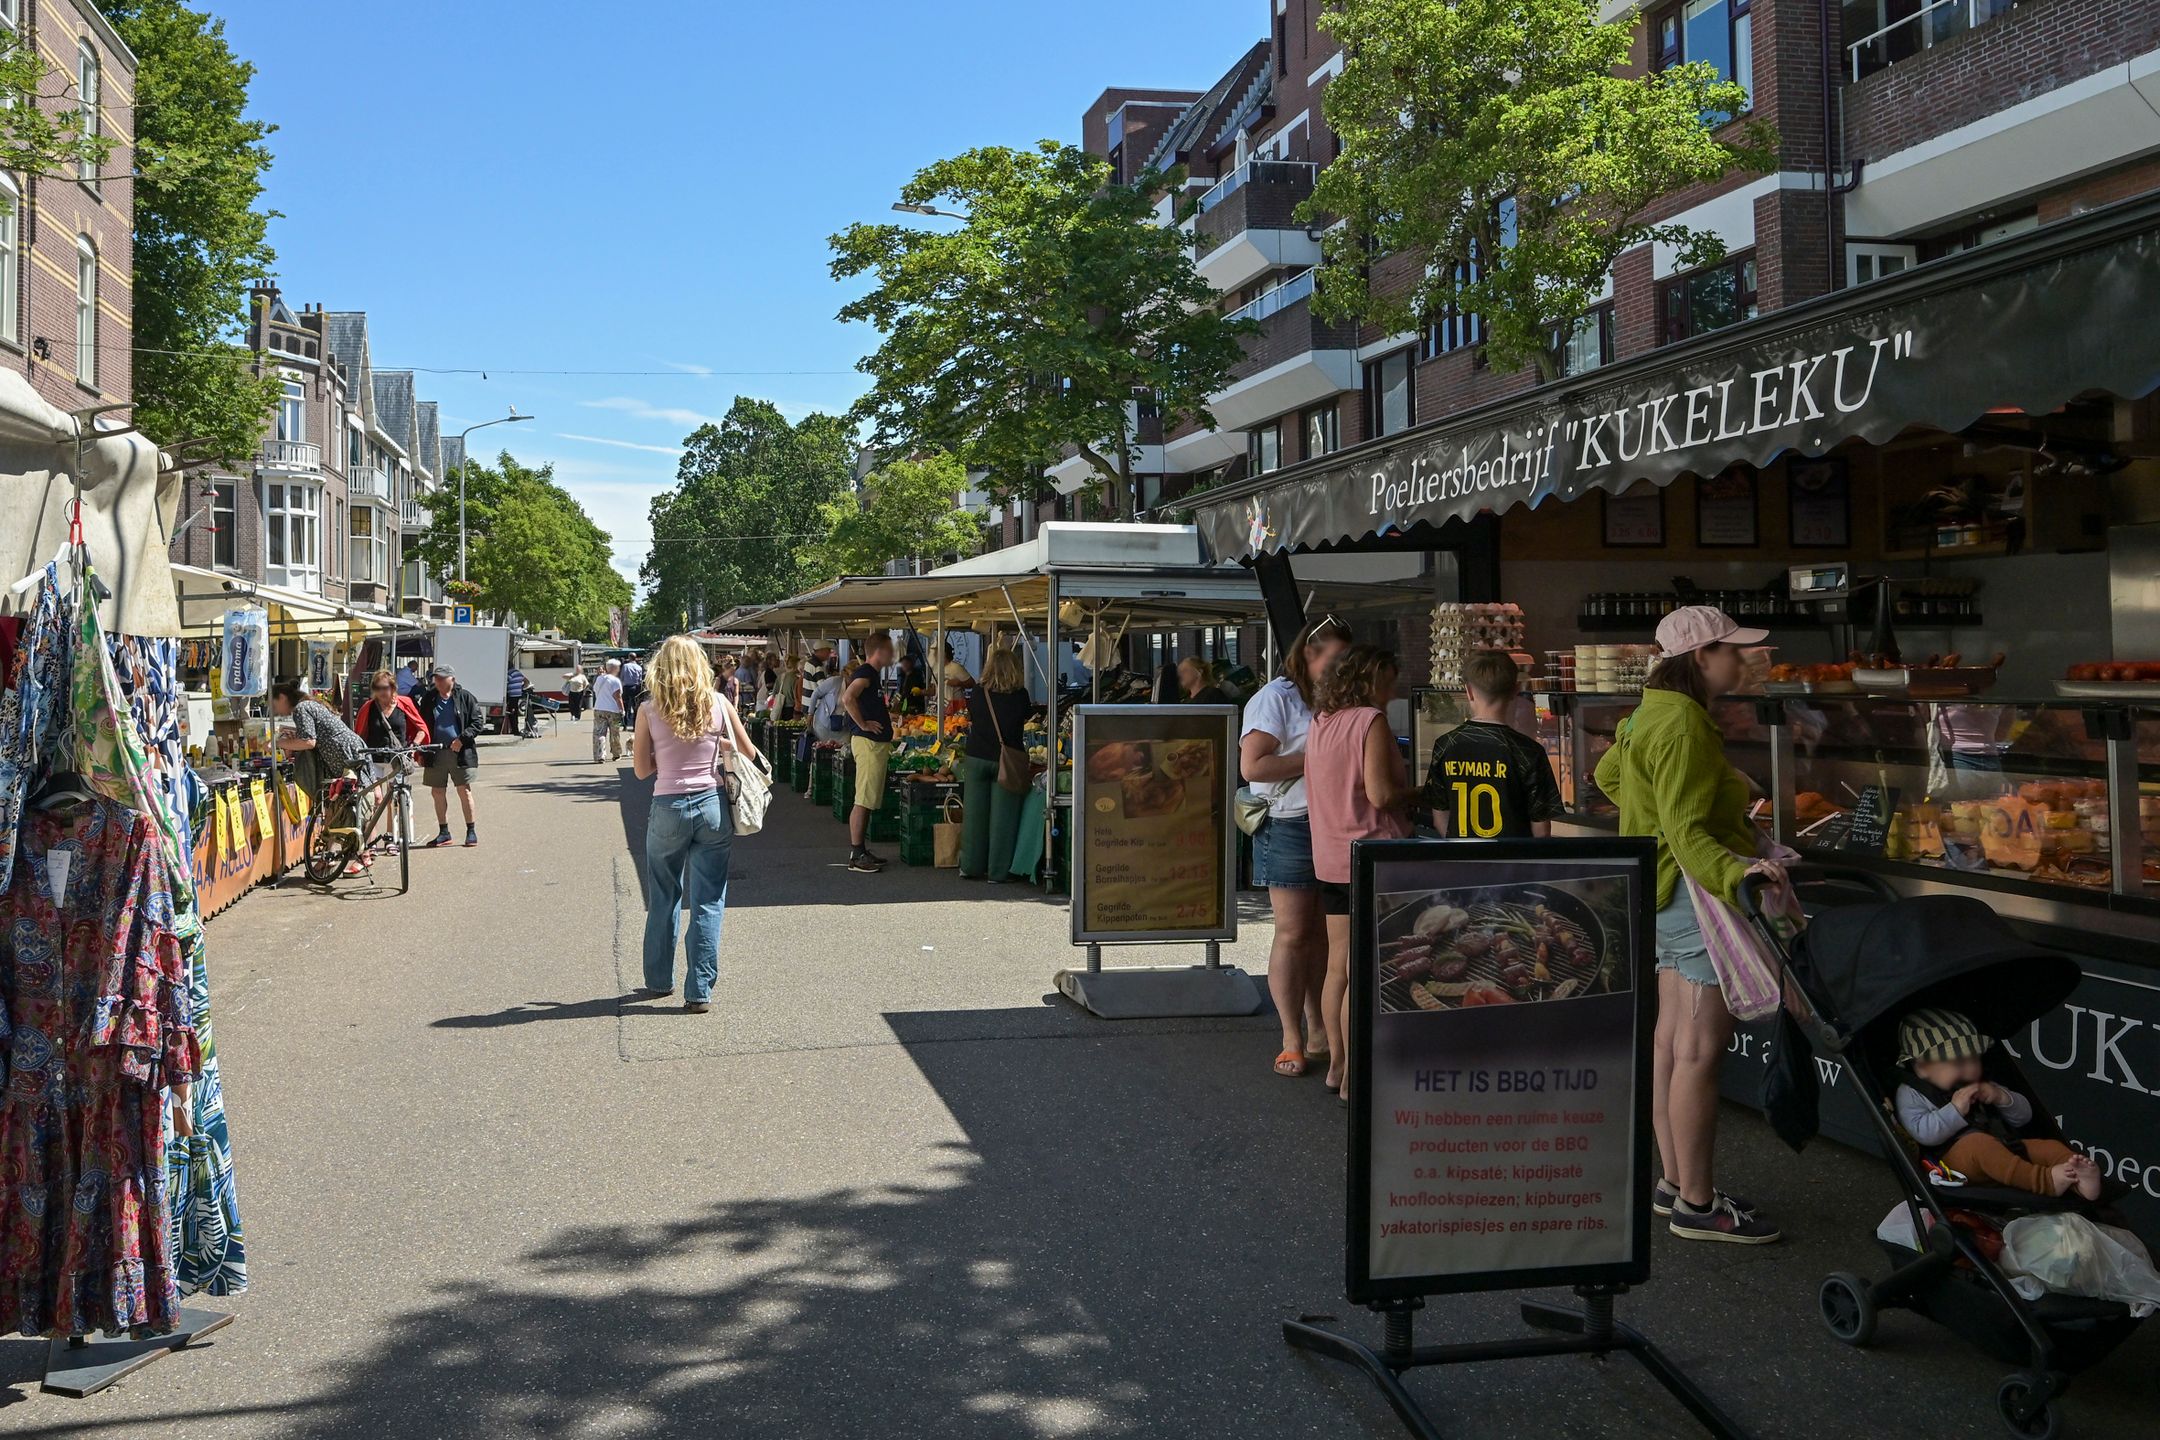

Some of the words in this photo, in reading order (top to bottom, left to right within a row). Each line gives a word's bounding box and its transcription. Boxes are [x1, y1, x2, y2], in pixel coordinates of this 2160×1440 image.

[1370, 421, 1559, 515] Poeliersbedrijf
[1564, 330, 1913, 472] "KUKELEKU"
[457, 609, 467, 621] P
[233, 641, 243, 685] paloma
[1445, 761, 1490, 777] NEYMAR
[1452, 781, 1503, 838] 10
[1095, 863, 1130, 874] Gegrilde
[1097, 902, 1131, 913] Gegrilde
[1415, 1070, 1461, 1092] HET
[1468, 1070, 1489, 1093] IS
[1497, 1070, 1546, 1093] BBQ
[1553, 1069, 1598, 1091] TIJD
[1394, 1110, 1420, 1128] Wij
[1424, 1109, 1481, 1126] hebben
[1486, 1113, 1512, 1125] een
[1517, 1110, 1558, 1124] ruime
[1563, 1110, 1605, 1124] keuze
[1408, 1137, 1488, 1155] producten
[1493, 1140, 1527, 1152] voor
[1531, 1137, 1549, 1152] de
[1555, 1137, 1589, 1152] BBQ
[1390, 1191, 1521, 1210] knoflookspiezen;
[1525, 1190, 1602, 1209] kipburgers
[1379, 1217, 1505, 1237] yakatorispiesjes
[1509, 1220, 1527, 1232] en
[1531, 1219, 1573, 1237] spare
[1576, 1216, 1608, 1230] ribs.
